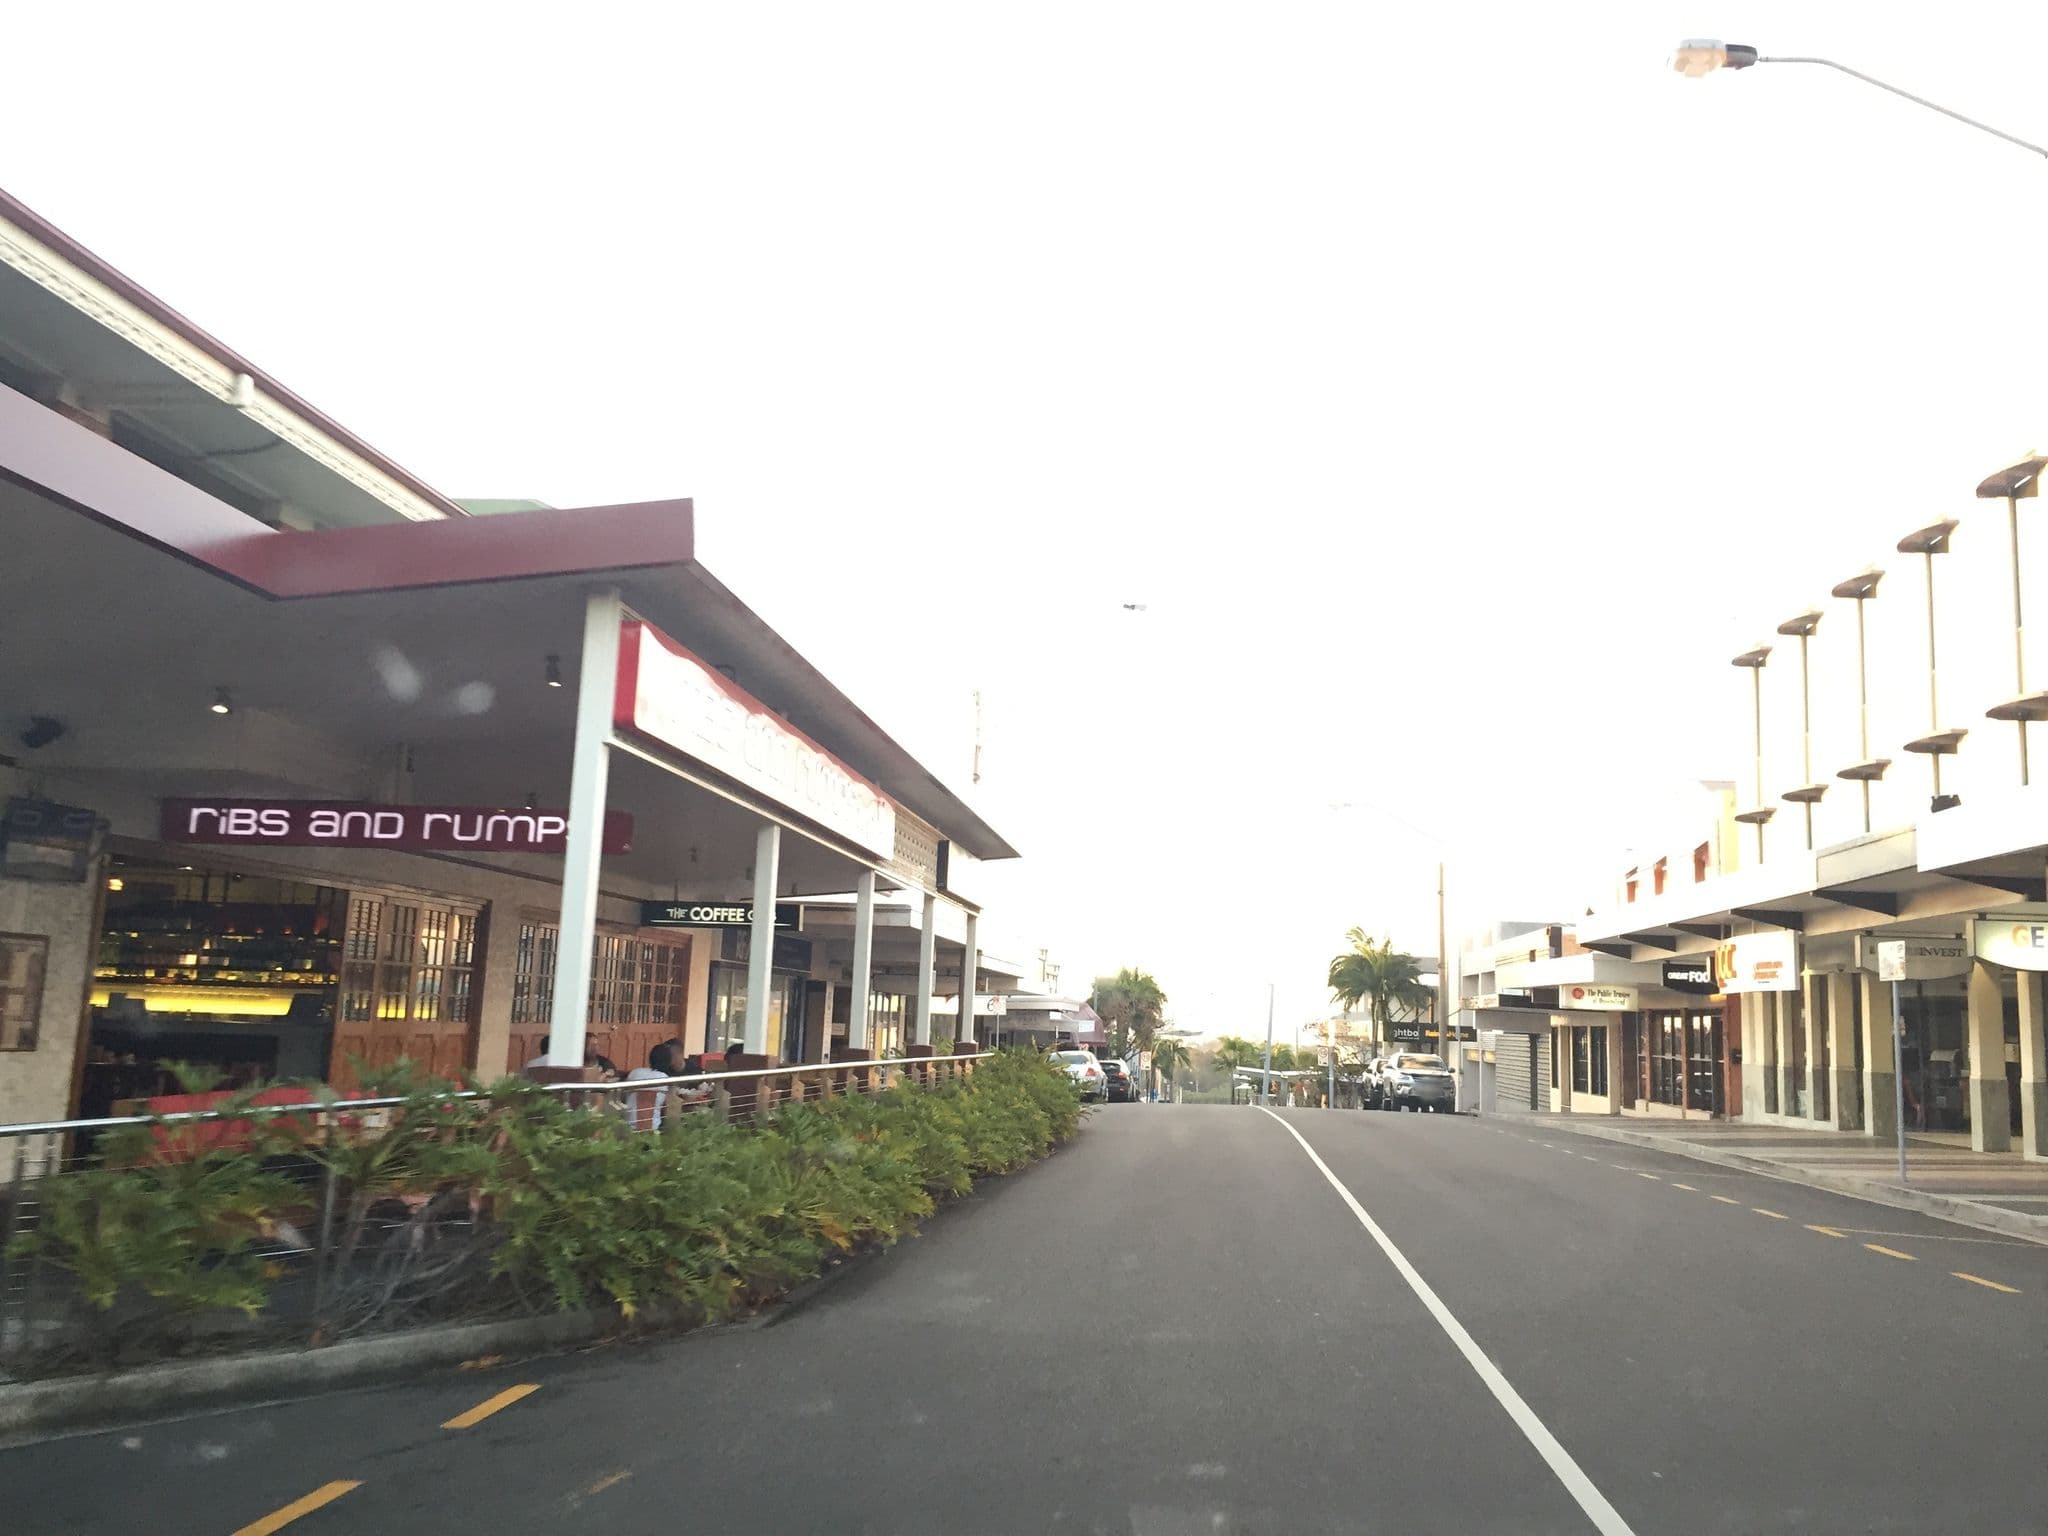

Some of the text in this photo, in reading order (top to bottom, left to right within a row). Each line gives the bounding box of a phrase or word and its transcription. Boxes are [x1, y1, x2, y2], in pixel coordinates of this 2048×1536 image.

[666, 907, 688, 919] THE
[690, 906, 745, 922] COFFEE
[2011, 925, 2045, 949] GE
[1688, 971, 1711, 983] FOO
